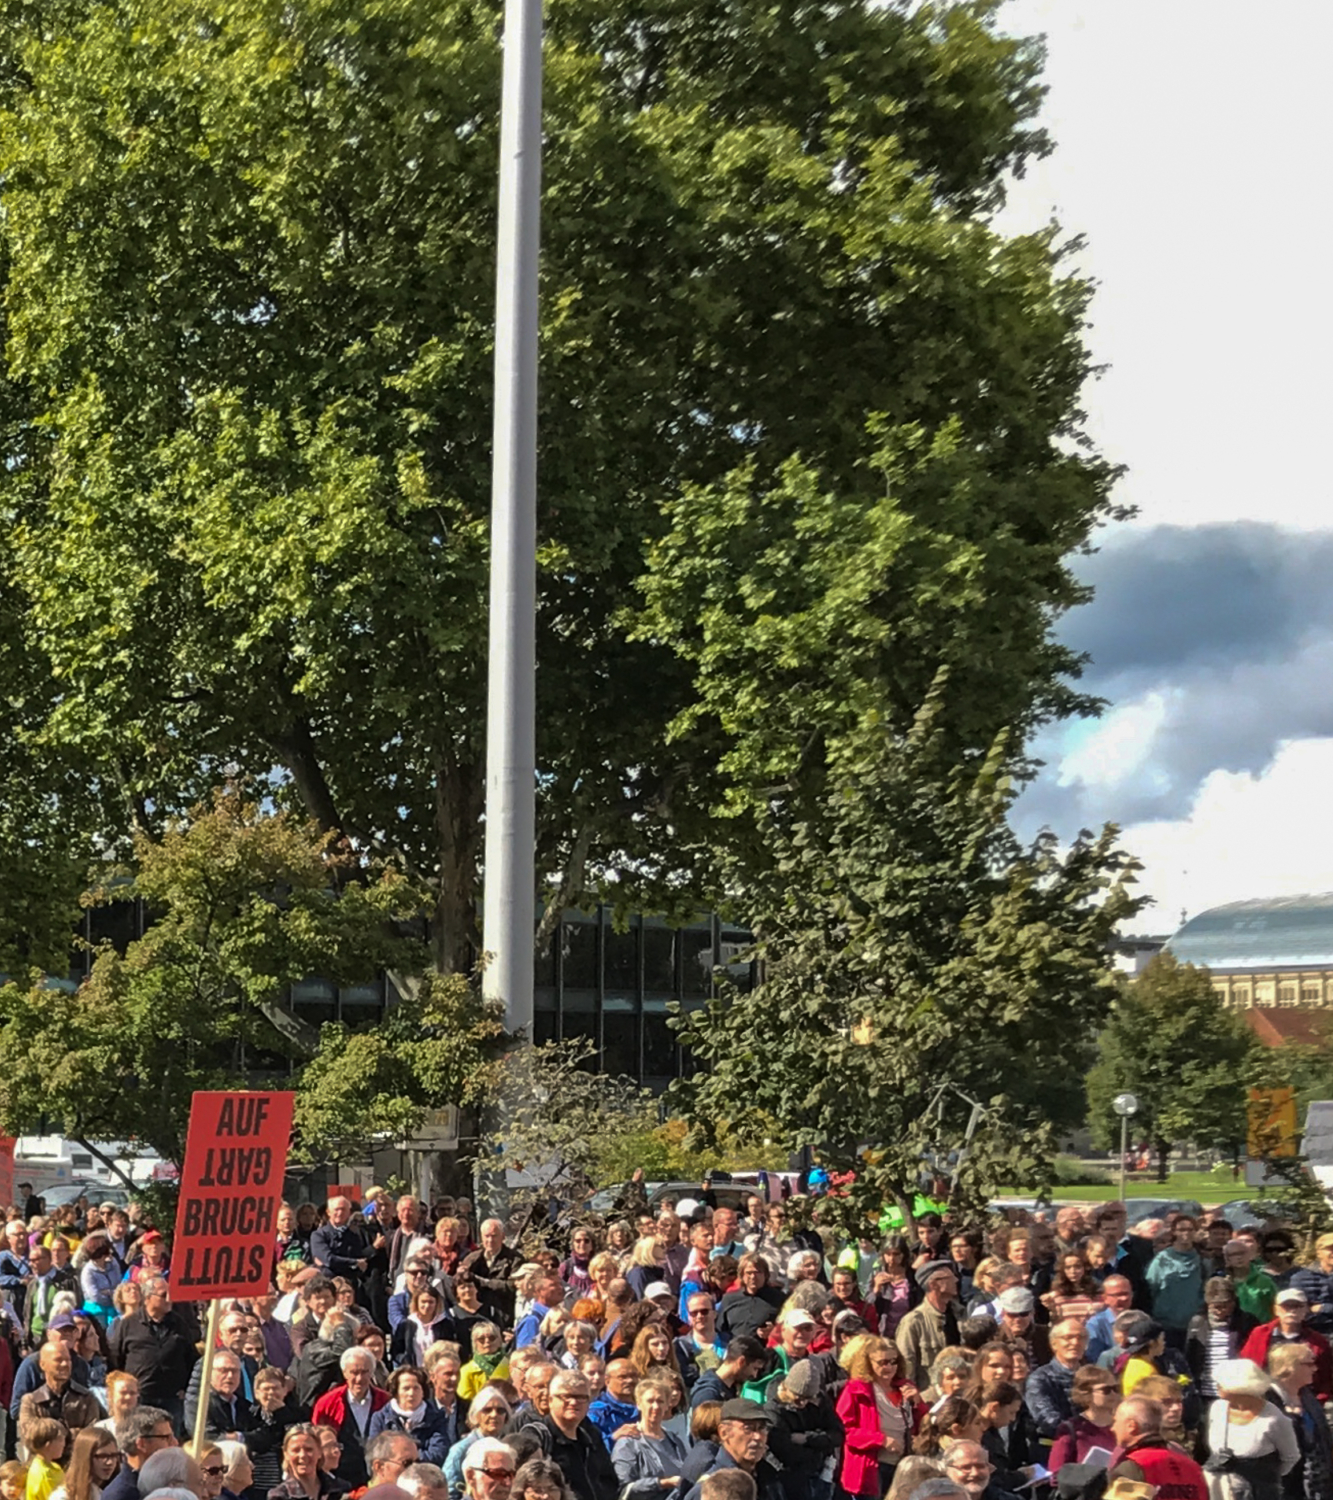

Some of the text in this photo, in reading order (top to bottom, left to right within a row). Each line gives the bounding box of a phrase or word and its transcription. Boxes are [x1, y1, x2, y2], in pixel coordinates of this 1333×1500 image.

[216, 1098, 270, 1137] AUF
[198, 1146, 272, 1187] GART
[183, 1197, 274, 1237] BRUCH
[178, 1245, 265, 1286] STUTT
